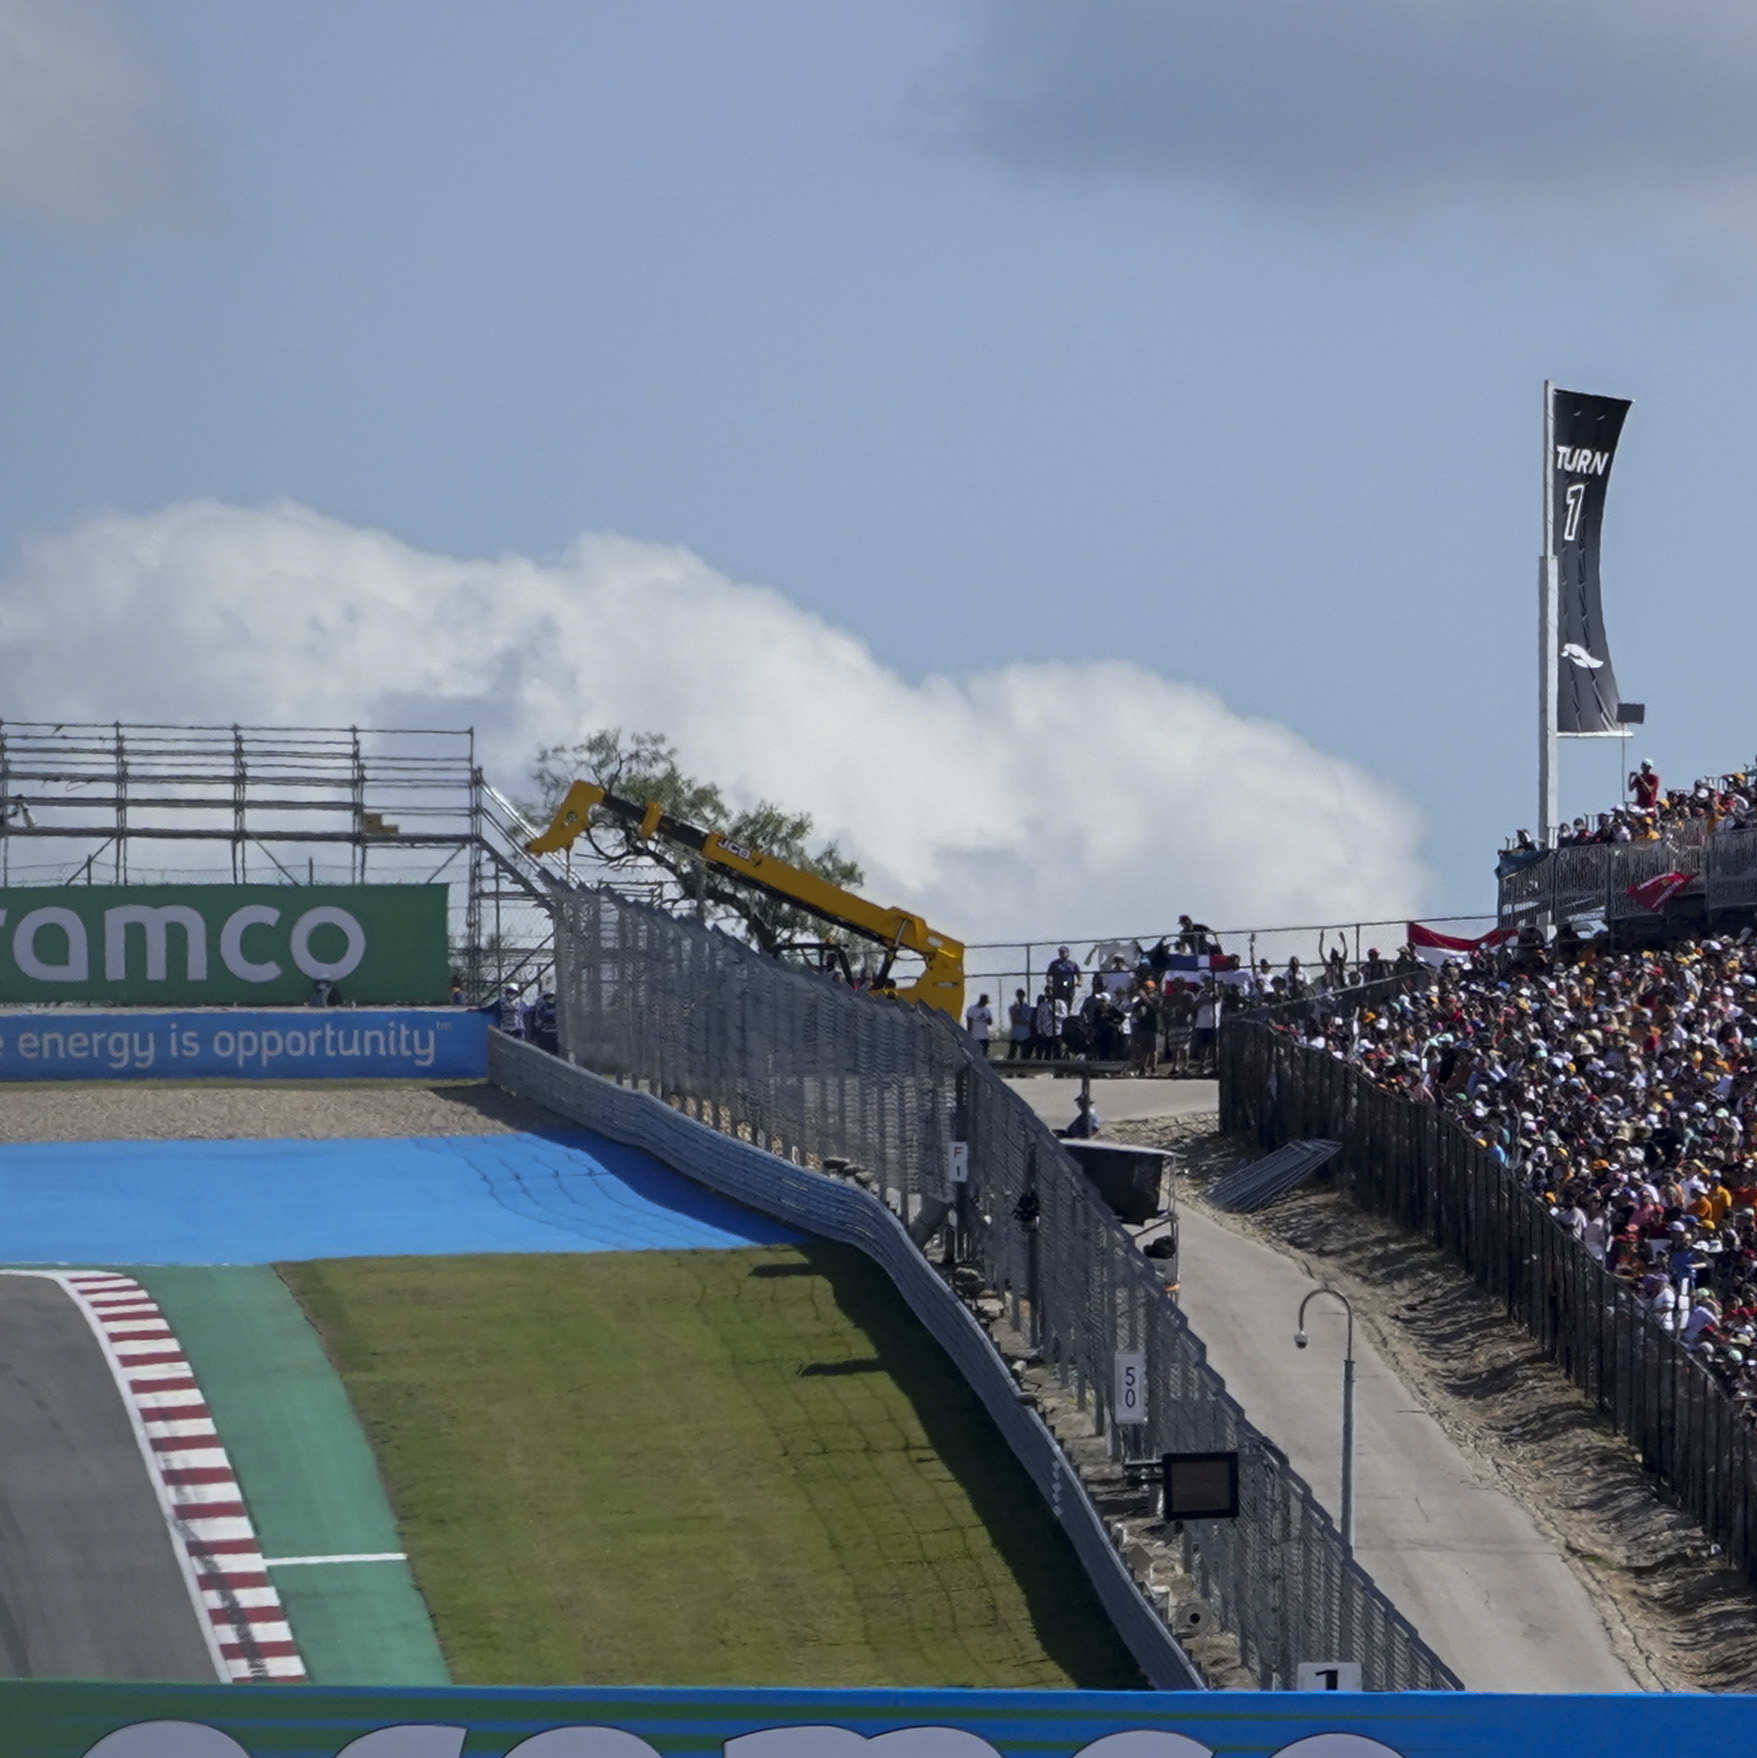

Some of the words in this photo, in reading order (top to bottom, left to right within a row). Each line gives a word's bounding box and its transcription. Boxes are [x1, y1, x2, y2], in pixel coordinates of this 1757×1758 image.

[1556, 445, 1609, 476] TURN
[1563, 484, 1585, 541] 1
[717, 840, 751, 860] JCB
[18, 1030, 156, 1070] energy
[169, 1022, 200, 1058] is
[213, 1020, 436, 1068] opportunity
[1125, 1366, 1136, 1408] 50
